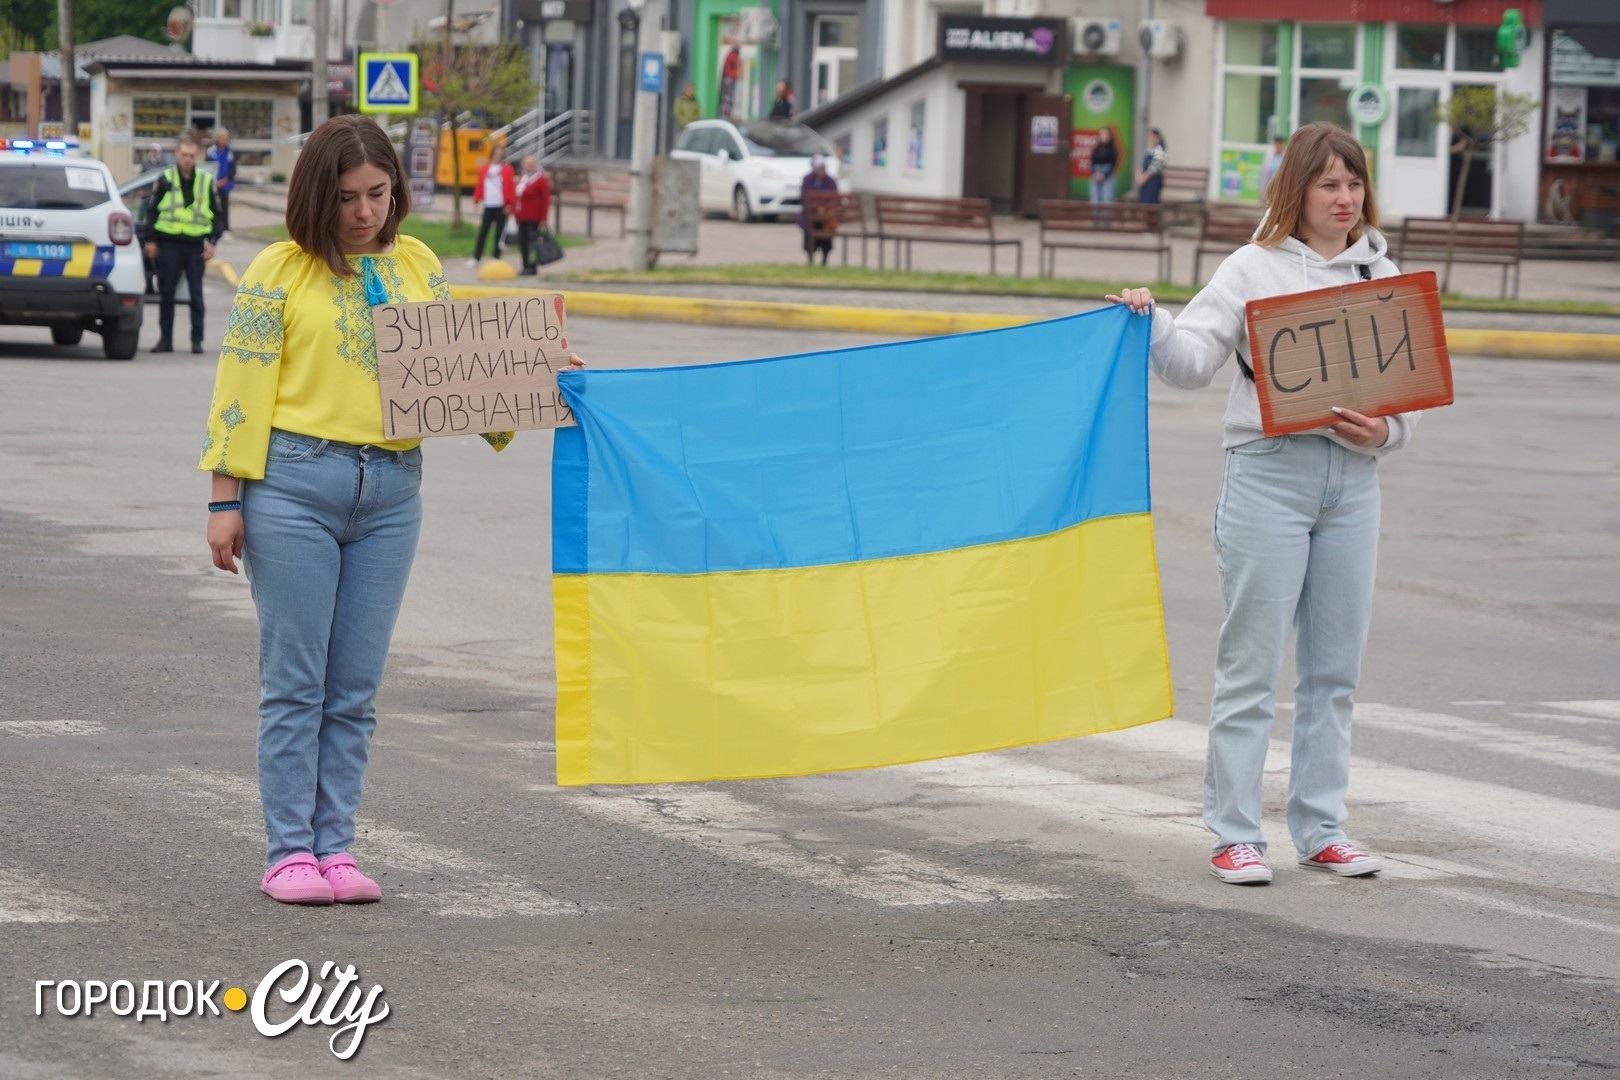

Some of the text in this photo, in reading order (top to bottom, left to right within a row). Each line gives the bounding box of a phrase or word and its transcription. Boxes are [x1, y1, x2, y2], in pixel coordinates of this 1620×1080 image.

[970, 30, 1024, 49] ALIEN
[36, 244, 65, 257] 1109
[380, 296, 568, 353] ЗУПИНИСЬ!
[1269, 289, 1416, 393] СТІЙ
[398, 347, 552, 389] ХВИЛИНА
